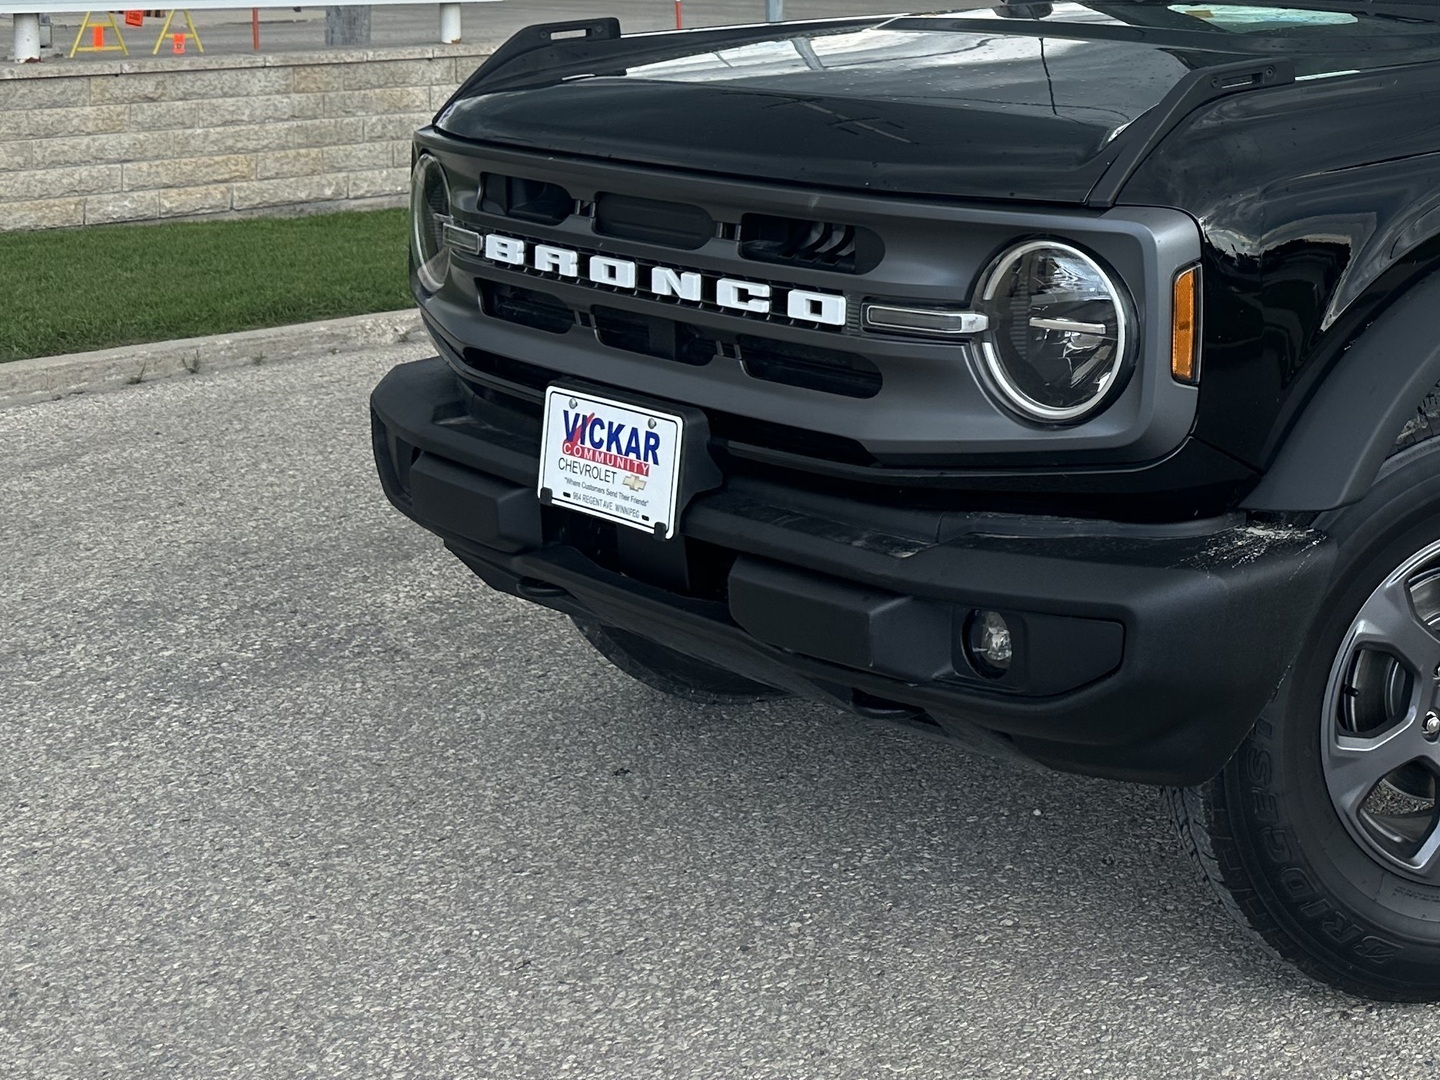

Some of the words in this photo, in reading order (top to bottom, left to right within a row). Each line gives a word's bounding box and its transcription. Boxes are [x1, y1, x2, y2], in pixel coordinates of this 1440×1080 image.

[485, 233, 846, 326] BRONCO
[563, 409, 660, 466] VICKAR
[558, 457, 617, 485] CHEVROLET
[563, 442, 650, 476] COMMUNITY
[581, 481, 606, 494] Customers
[606, 488, 618, 498] Send
[619, 491, 630, 501] Their
[582, 493, 602, 508] REGENT
[614, 503, 640, 519] WINNIPEG
